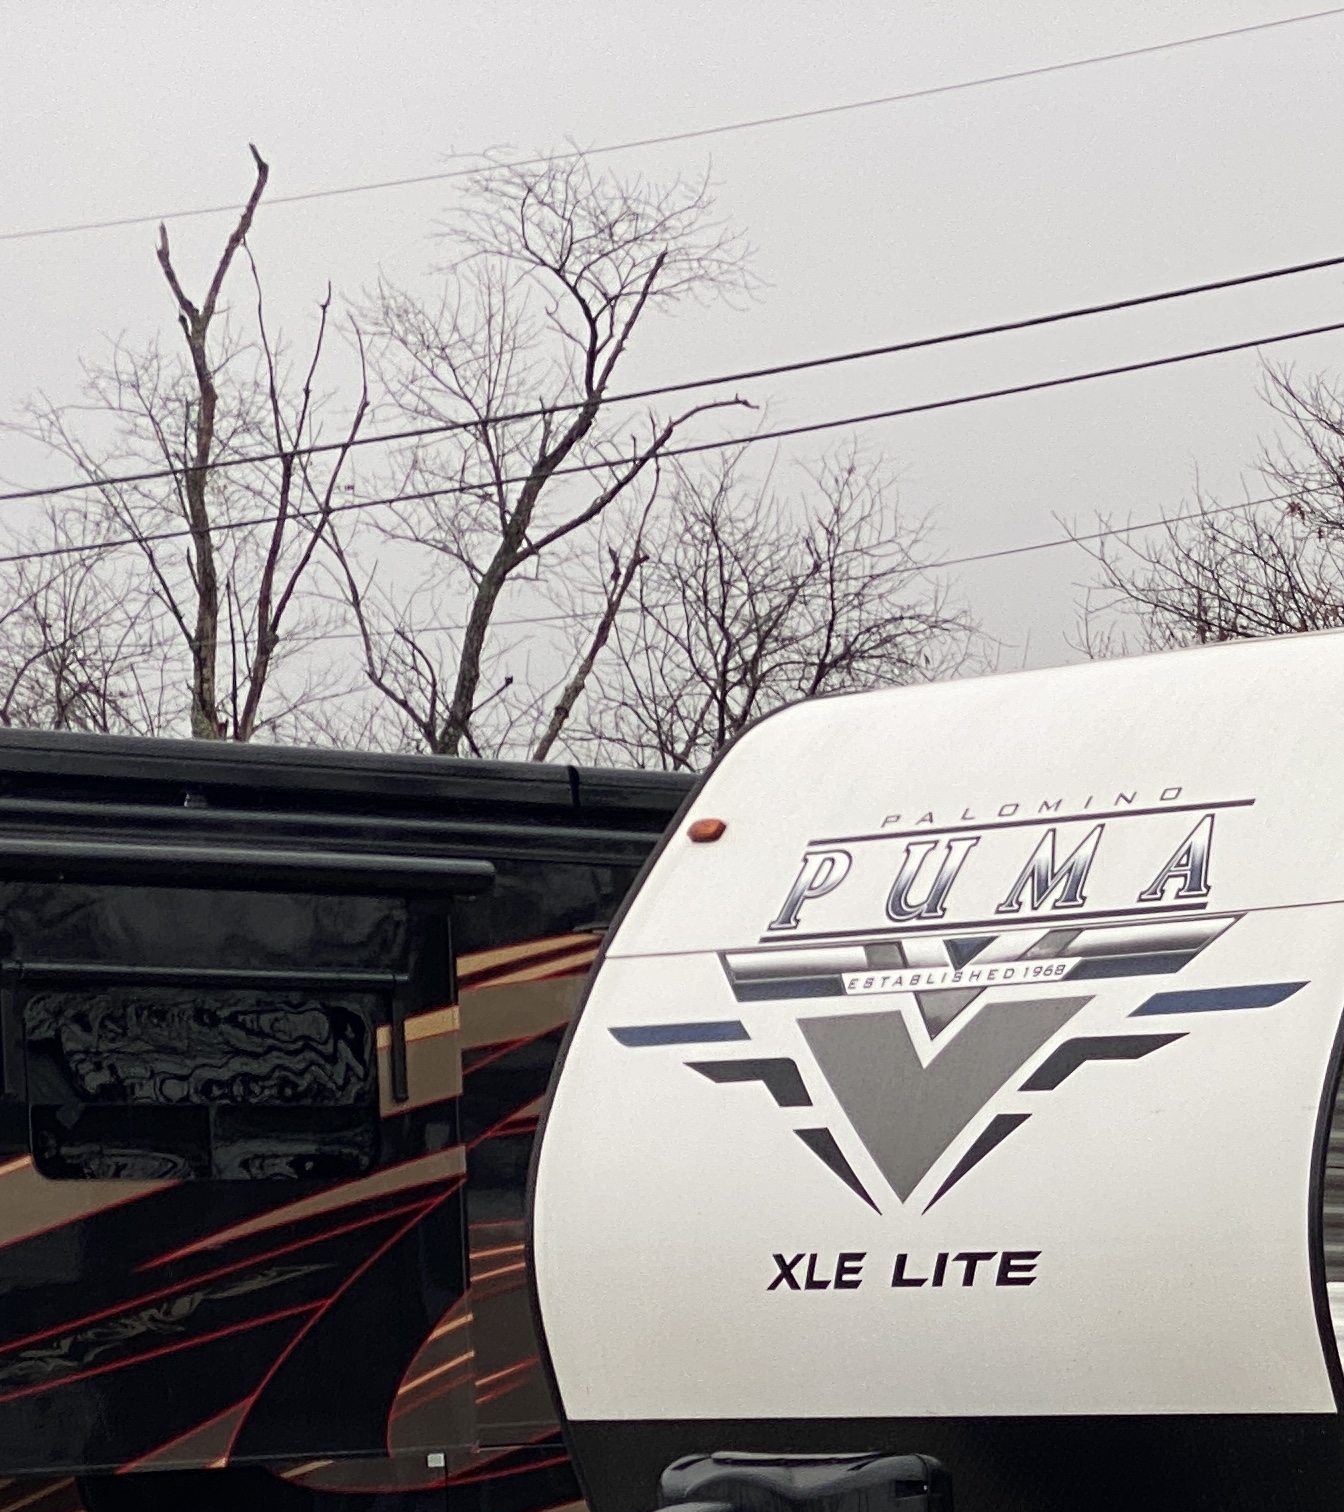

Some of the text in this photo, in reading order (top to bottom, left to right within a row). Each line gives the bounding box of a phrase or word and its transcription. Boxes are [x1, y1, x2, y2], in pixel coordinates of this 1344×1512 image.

[881, 786, 1182, 828] PALOMINO
[767, 813, 1216, 931] PUMA
[847, 964, 1067, 990] ESTABLISHED 1968
[766, 1251, 1042, 1290] XLE LITE
